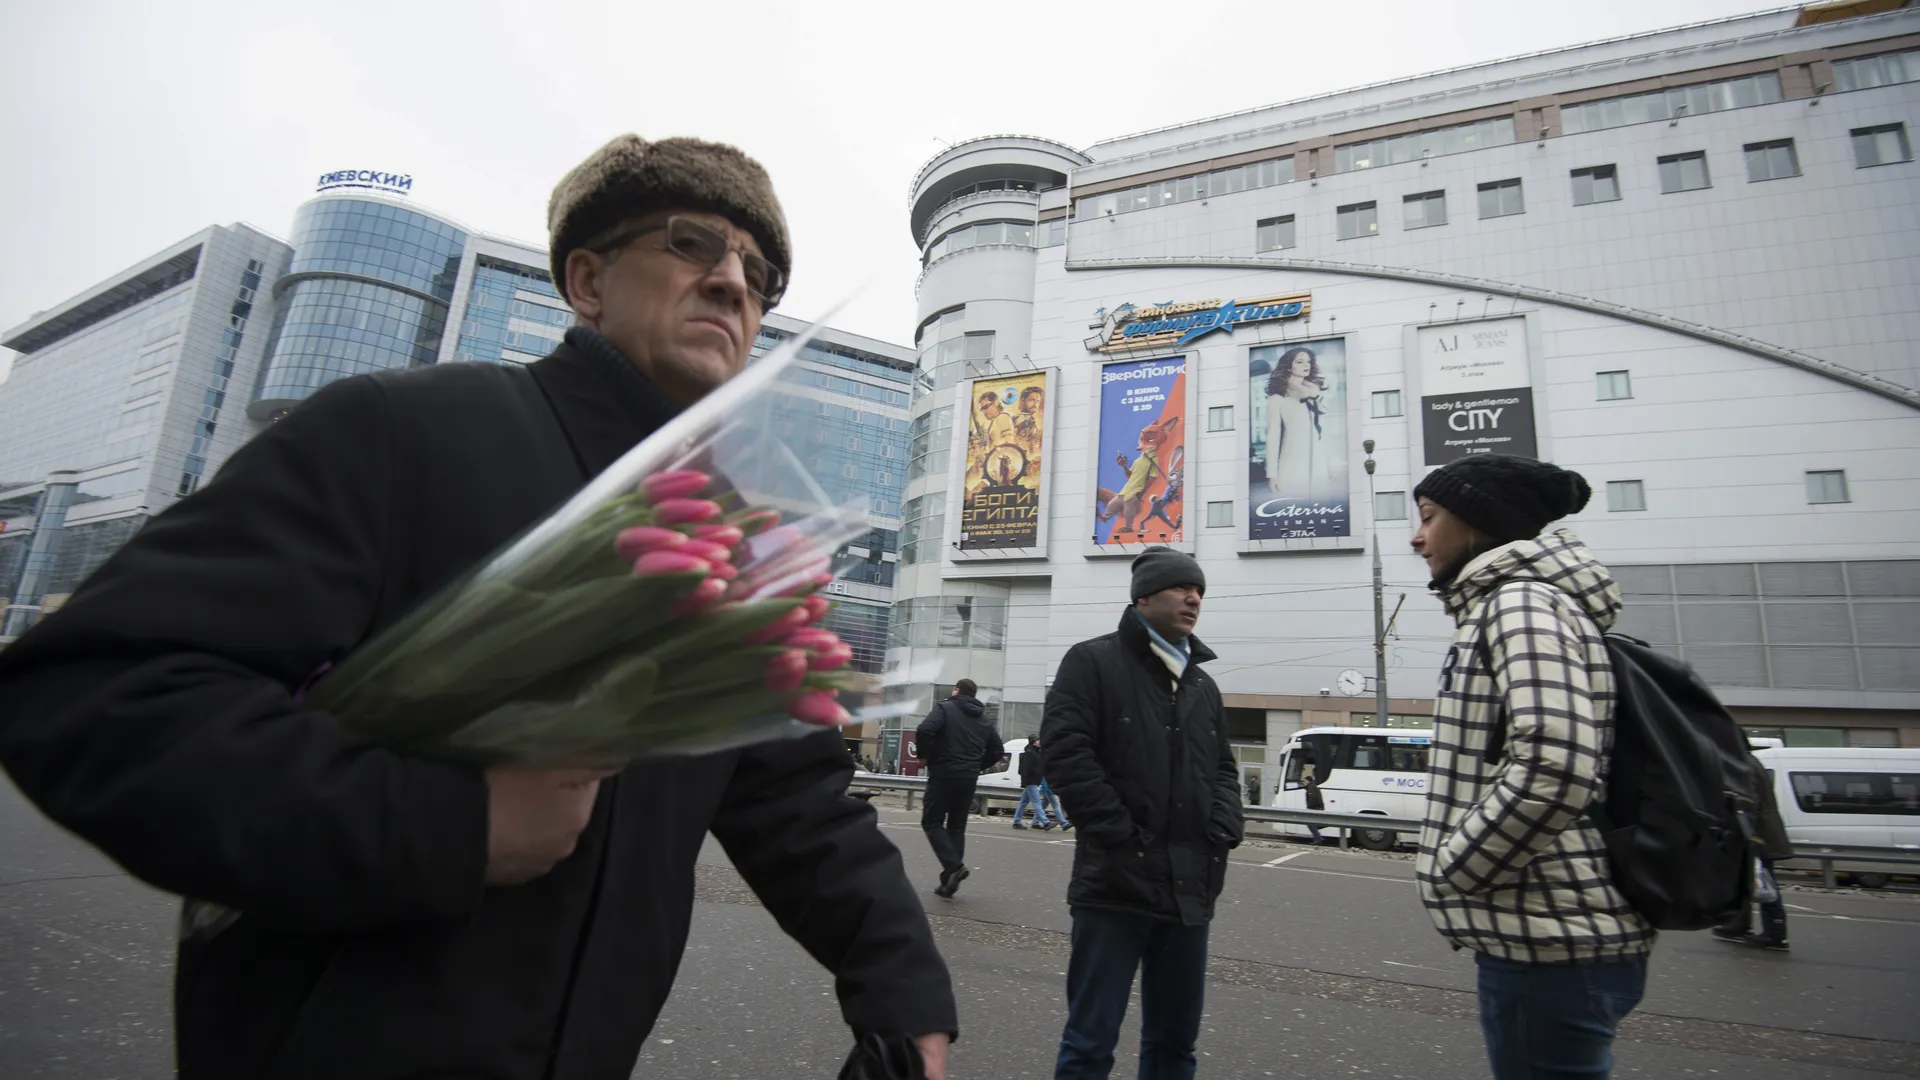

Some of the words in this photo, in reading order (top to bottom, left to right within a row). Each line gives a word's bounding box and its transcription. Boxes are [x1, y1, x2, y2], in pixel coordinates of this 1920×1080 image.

[318, 170, 413, 189] КИЕВСКИЙ
[1136, 298, 1221, 318] КИНОТЕАТР
[1134, 386, 1160, 395] КИНО
[1134, 394, 1166, 403] МАРТА
[1432, 402, 1454, 411] lady
[1455, 401, 1463, 409] &
[1464, 397, 1520, 410] gentleman
[1448, 408, 1504, 432] CITY
[974, 492, 1032, 507] БОГИ
[963, 506, 1038, 521] ЕГИПТА
[1255, 497, 1344, 518] Caterina
